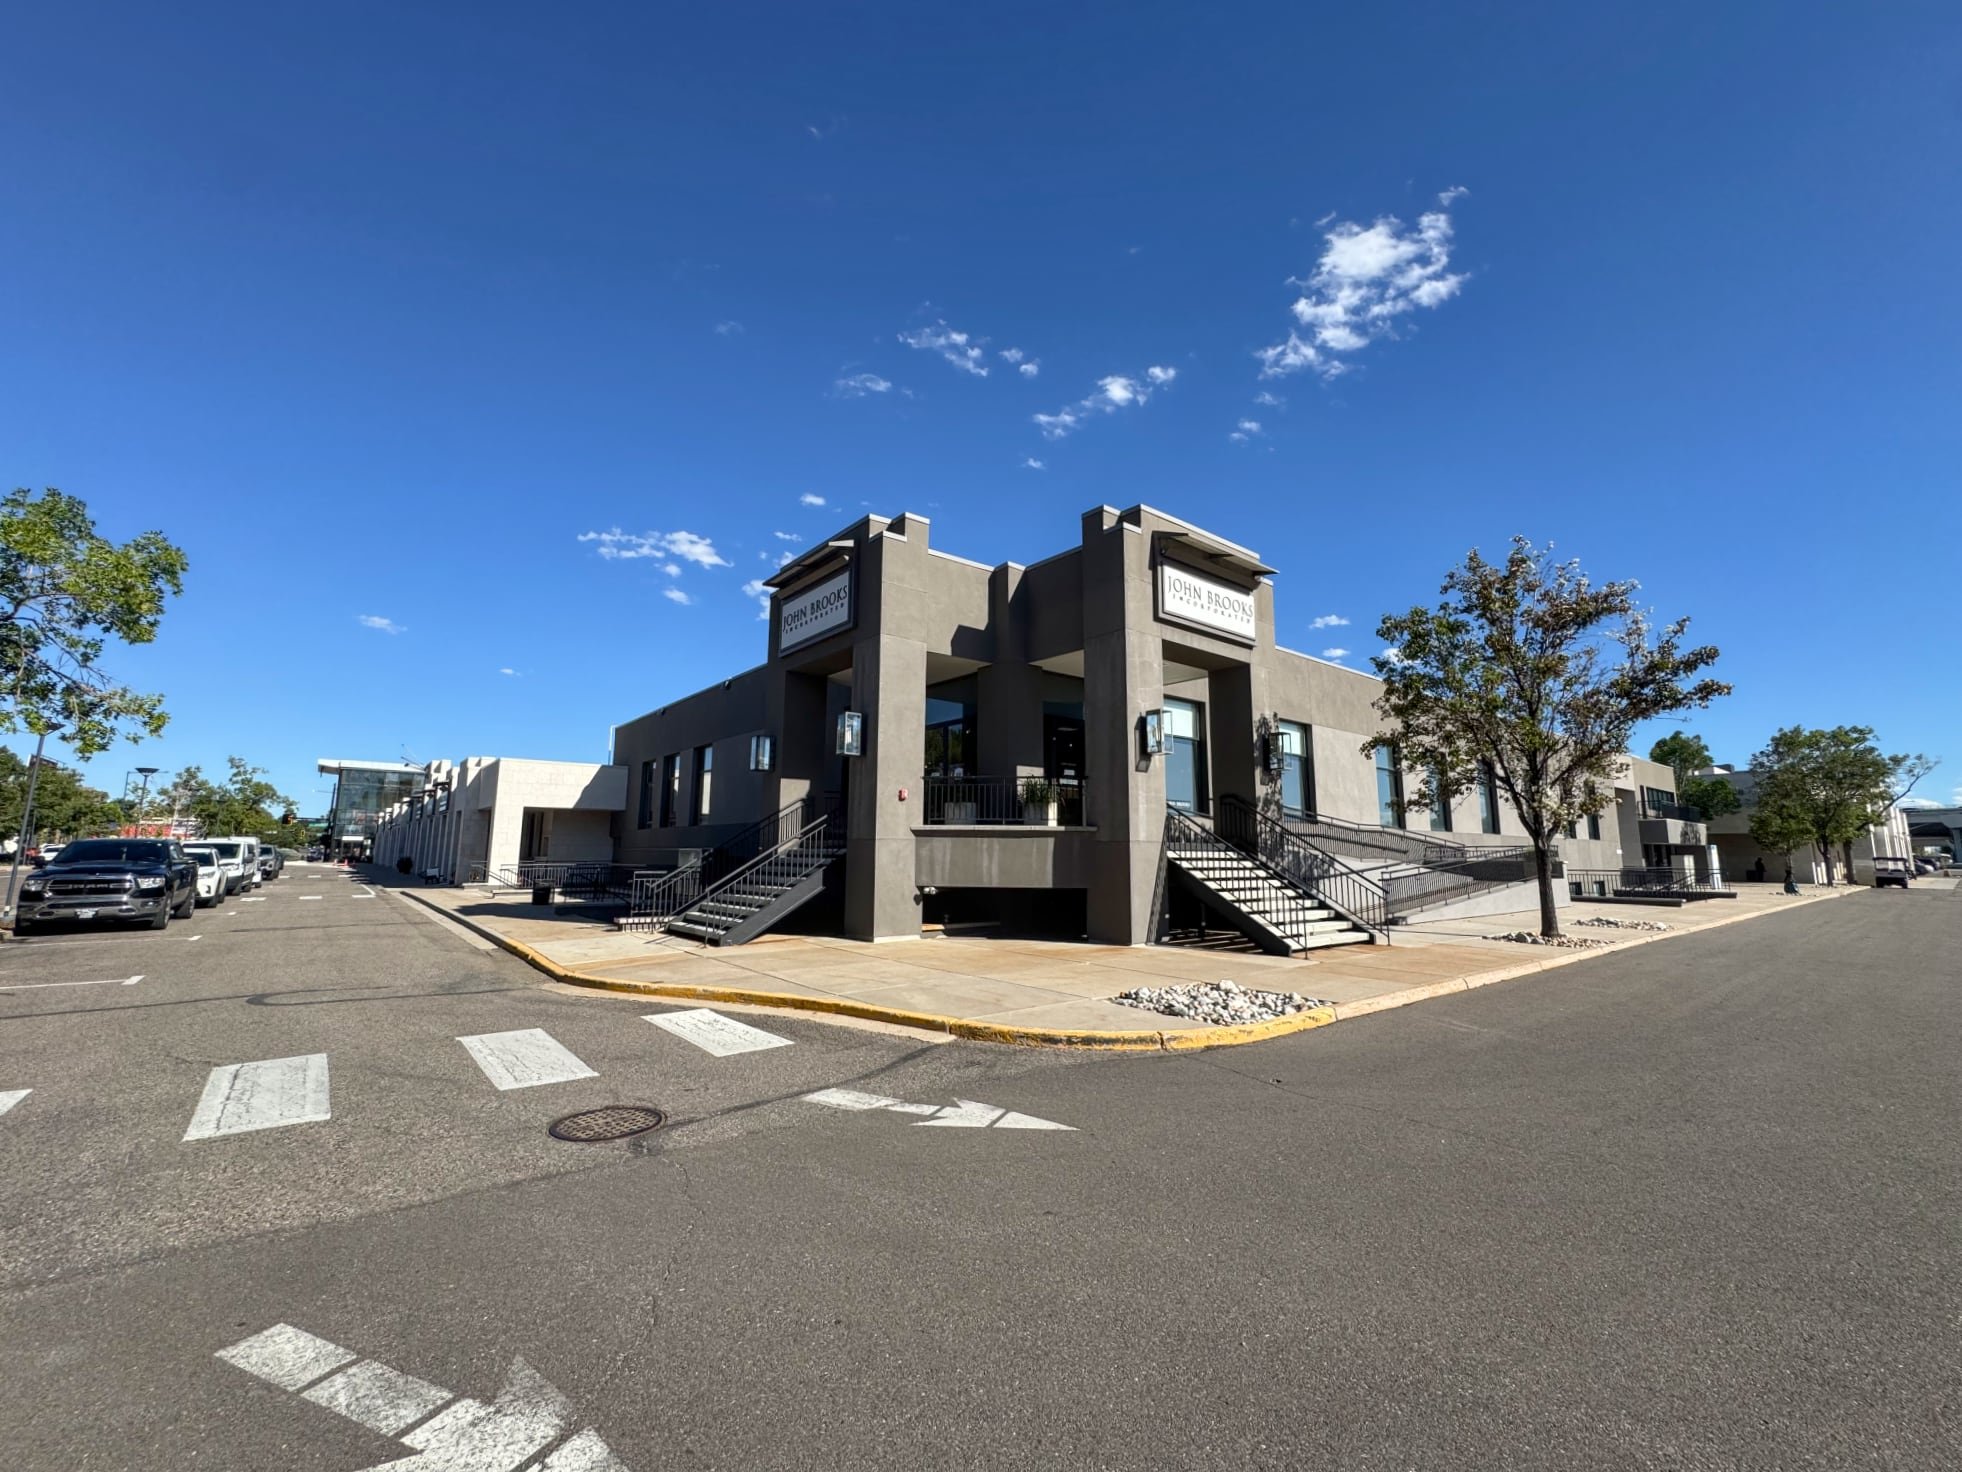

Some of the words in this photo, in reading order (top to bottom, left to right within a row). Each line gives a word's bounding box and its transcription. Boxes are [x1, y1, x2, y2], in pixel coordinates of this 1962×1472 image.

[782, 605, 808, 633] JOHN
[810, 584, 848, 616] BROOKS
[1168, 575, 1202, 601] JOHN
[1207, 590, 1254, 618] BROOKS
